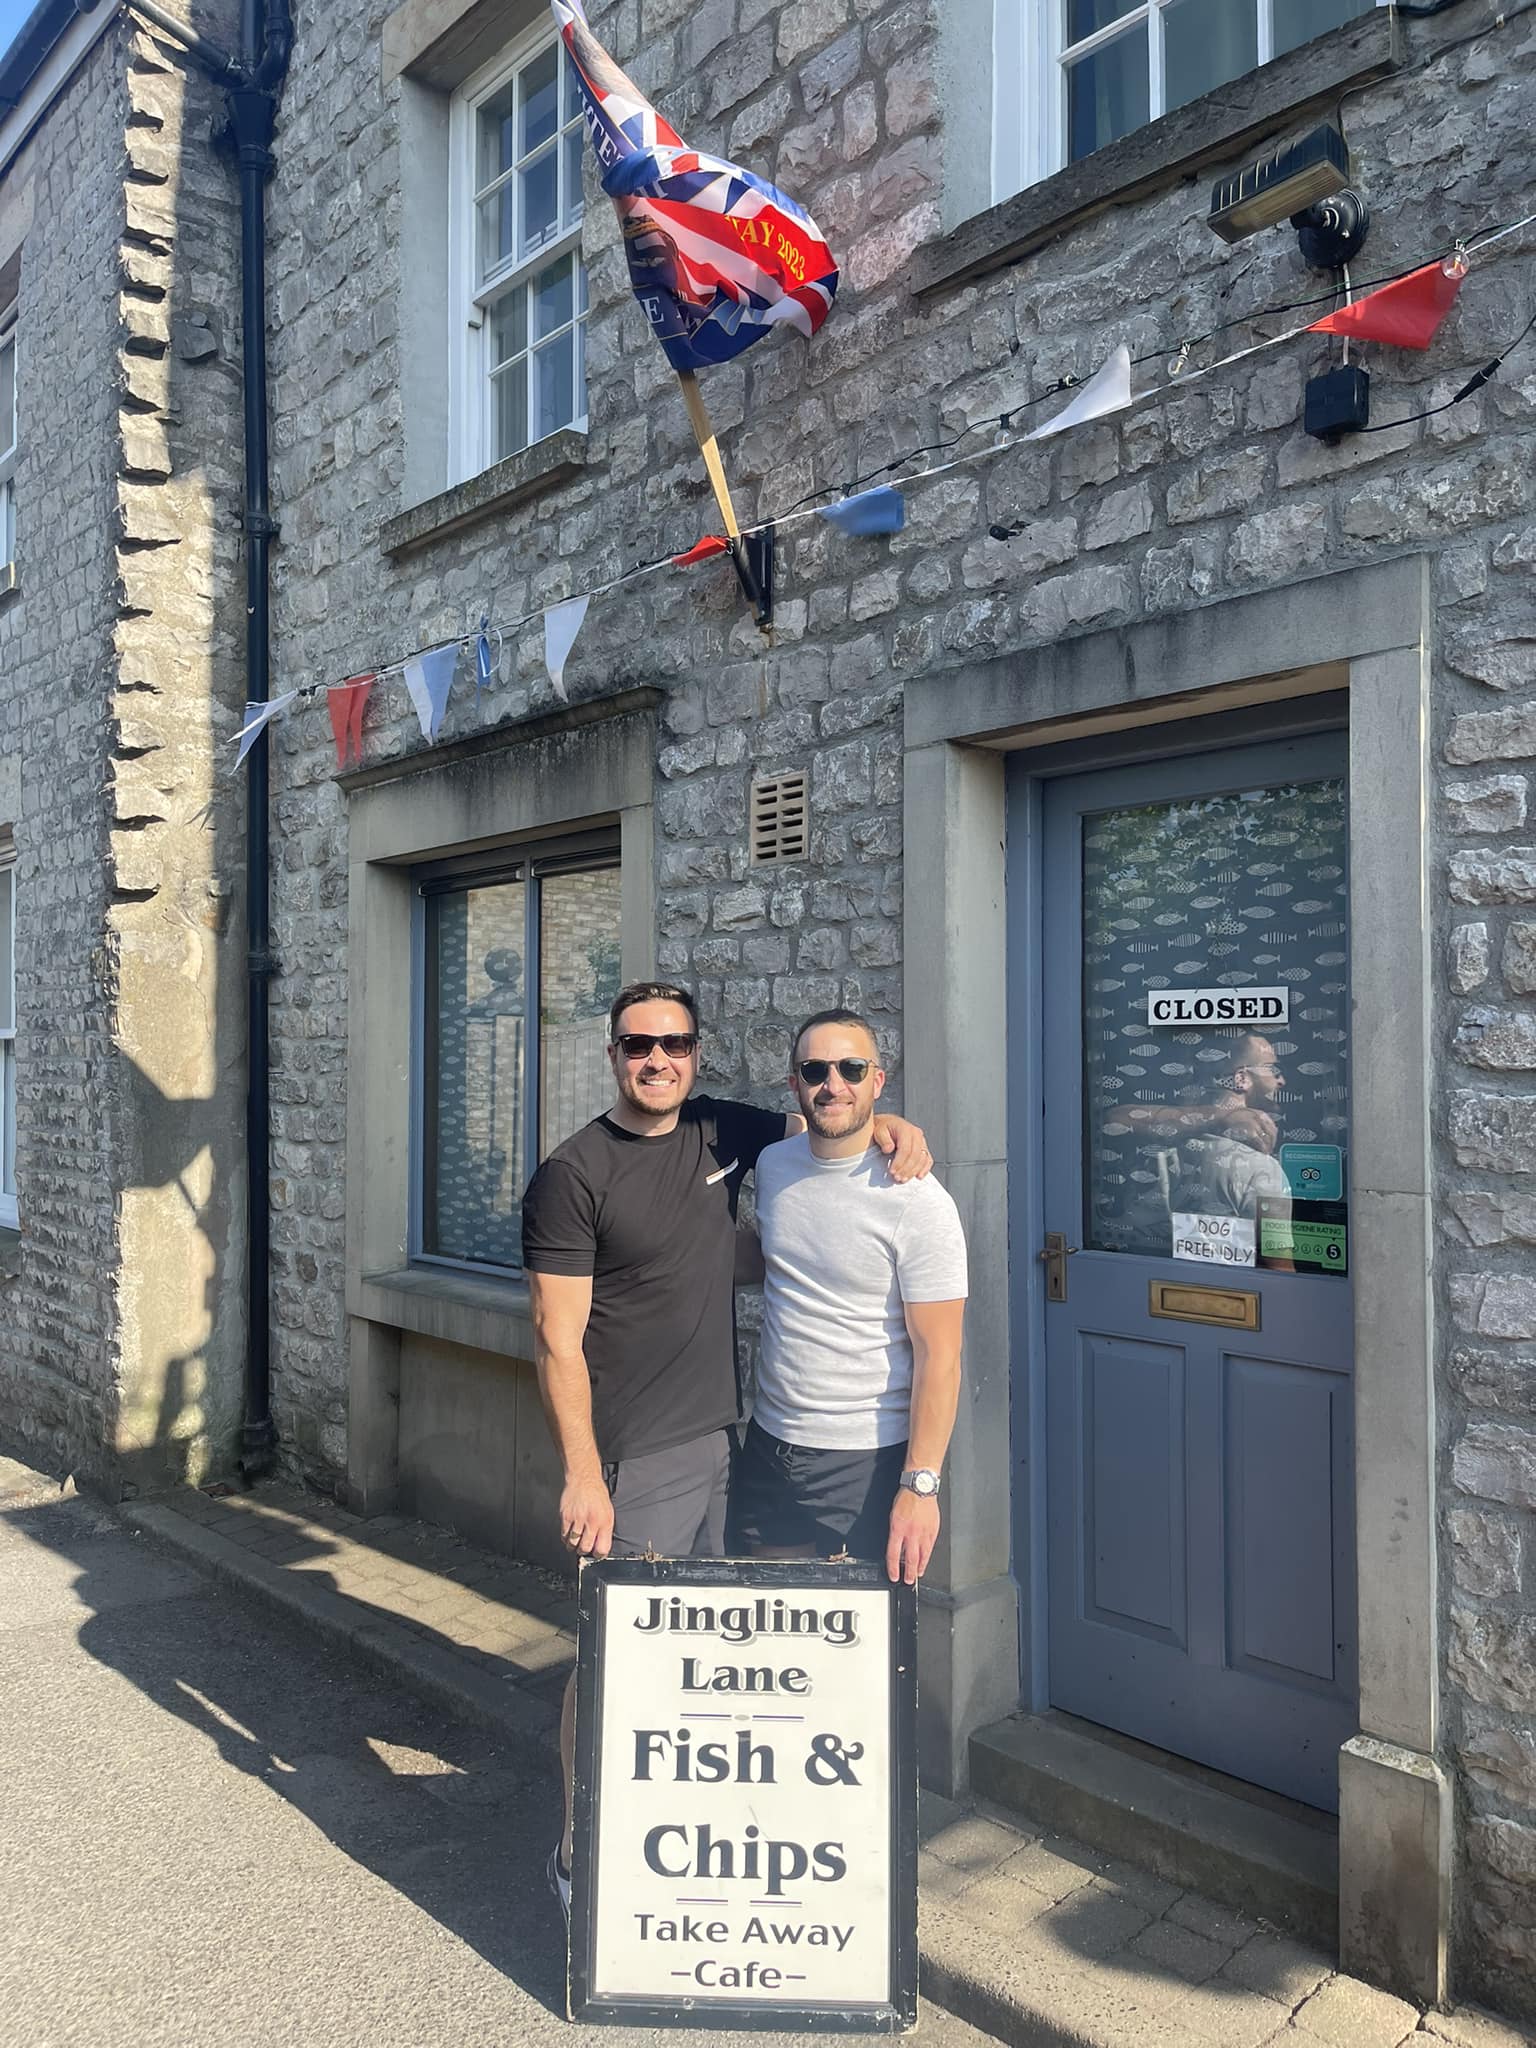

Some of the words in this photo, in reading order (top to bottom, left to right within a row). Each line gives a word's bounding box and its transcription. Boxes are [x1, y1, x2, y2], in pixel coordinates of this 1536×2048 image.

[777, 232, 806, 281] 2023
[1153, 997, 1284, 1021] CLOSED
[1199, 1219, 1231, 1237] DOG
[1264, 1221, 1286, 1231] FOOD
[1316, 1225, 1342, 1235] RATING
[1176, 1239, 1253, 1263] FRIENDLY
[1329, 1245, 1338, 1258] 5
[634, 1597, 857, 1645] Jingling
[681, 1657, 809, 1694] Lane
[631, 1729, 777, 1784] Fish
[804, 1733, 864, 1786] &
[643, 1824, 847, 1896] Chips
[634, 1914, 729, 1943] Take
[742, 1917, 855, 1952] Away
